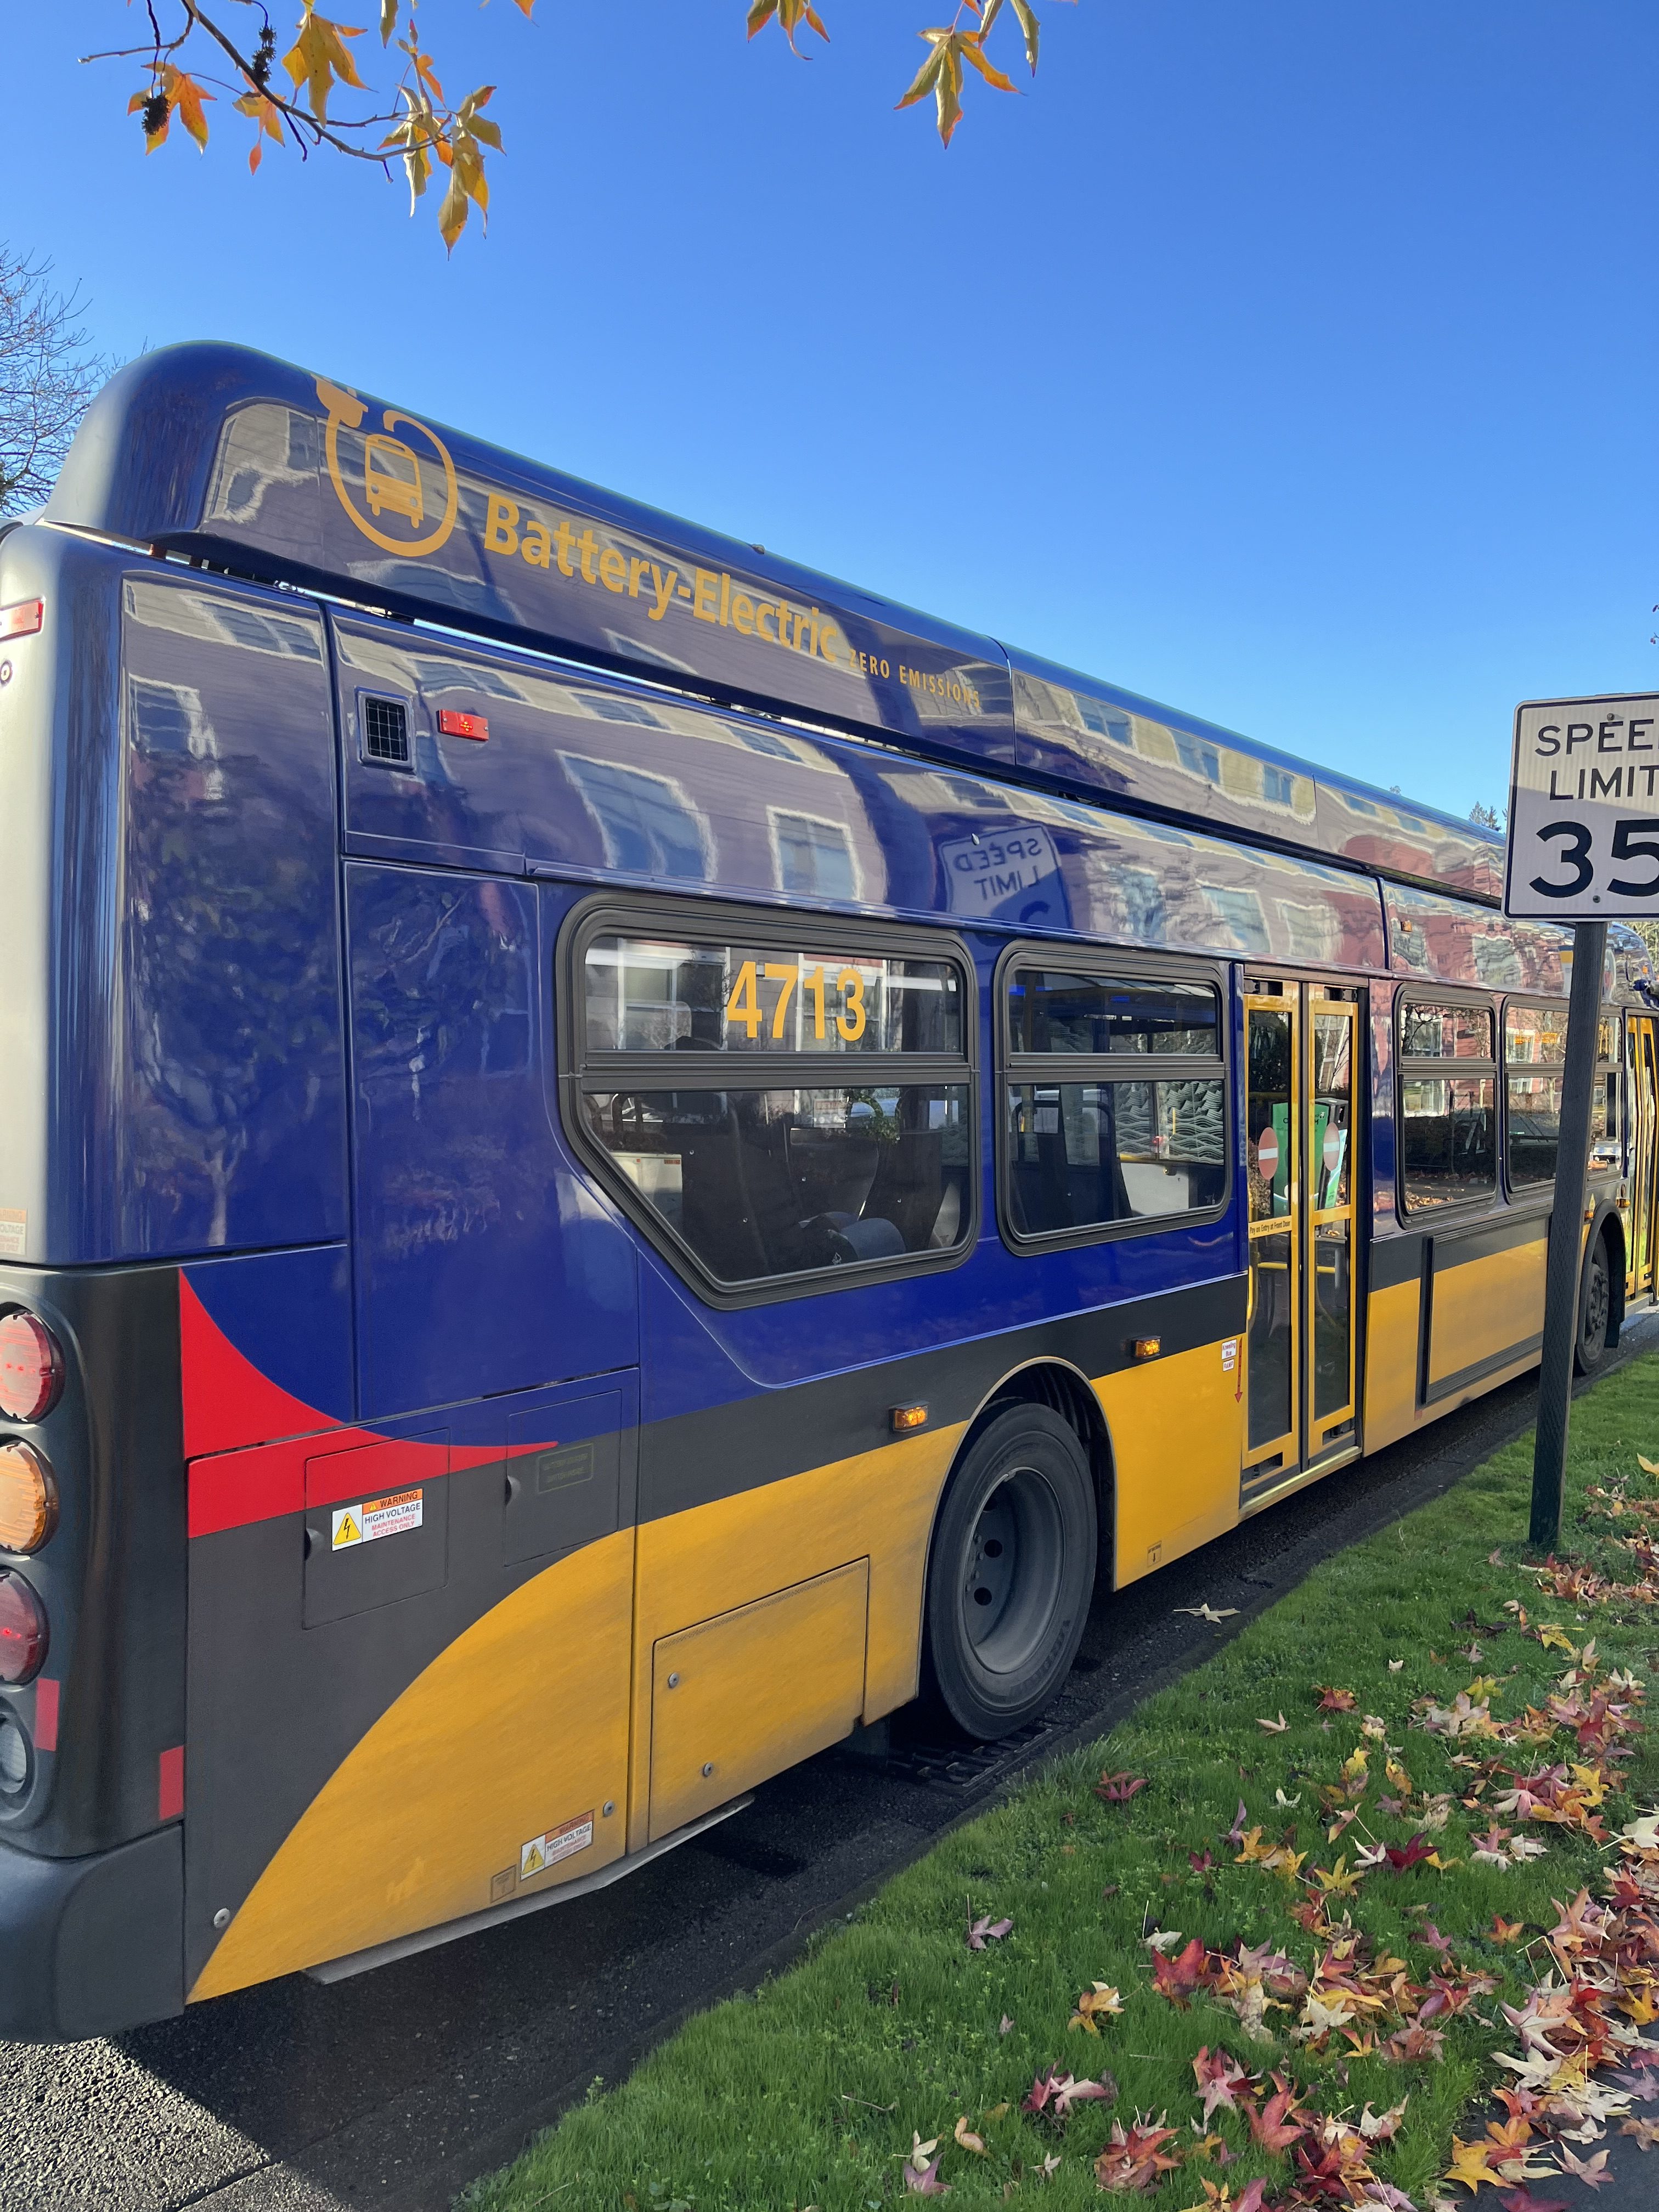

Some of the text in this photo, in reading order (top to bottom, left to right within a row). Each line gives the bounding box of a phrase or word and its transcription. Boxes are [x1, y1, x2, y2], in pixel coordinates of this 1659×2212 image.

[484, 493, 838, 662] Battery-Electric
[849, 648, 980, 708] ZERO EMISSIONS
[1535, 719, 1659, 756] SPEE
[1550, 765, 1659, 800] LIMIT
[1529, 819, 1659, 898] 35
[727, 961, 866, 1041] 4713
[1599, 1024, 1614, 1054] 713
[0, 1224, 24, 1234] OLTAGE
[365, 1503, 421, 1524] HIGH VOLTAGE
[380, 1492, 417, 1508] WARNING
[371, 1514, 416, 1530] MAINTENANCE
[373, 1520, 415, 1537] ACCESS ONLY
[547, 1838, 563, 1852] HIGH
[563, 1823, 591, 1842] VOLTAGE
